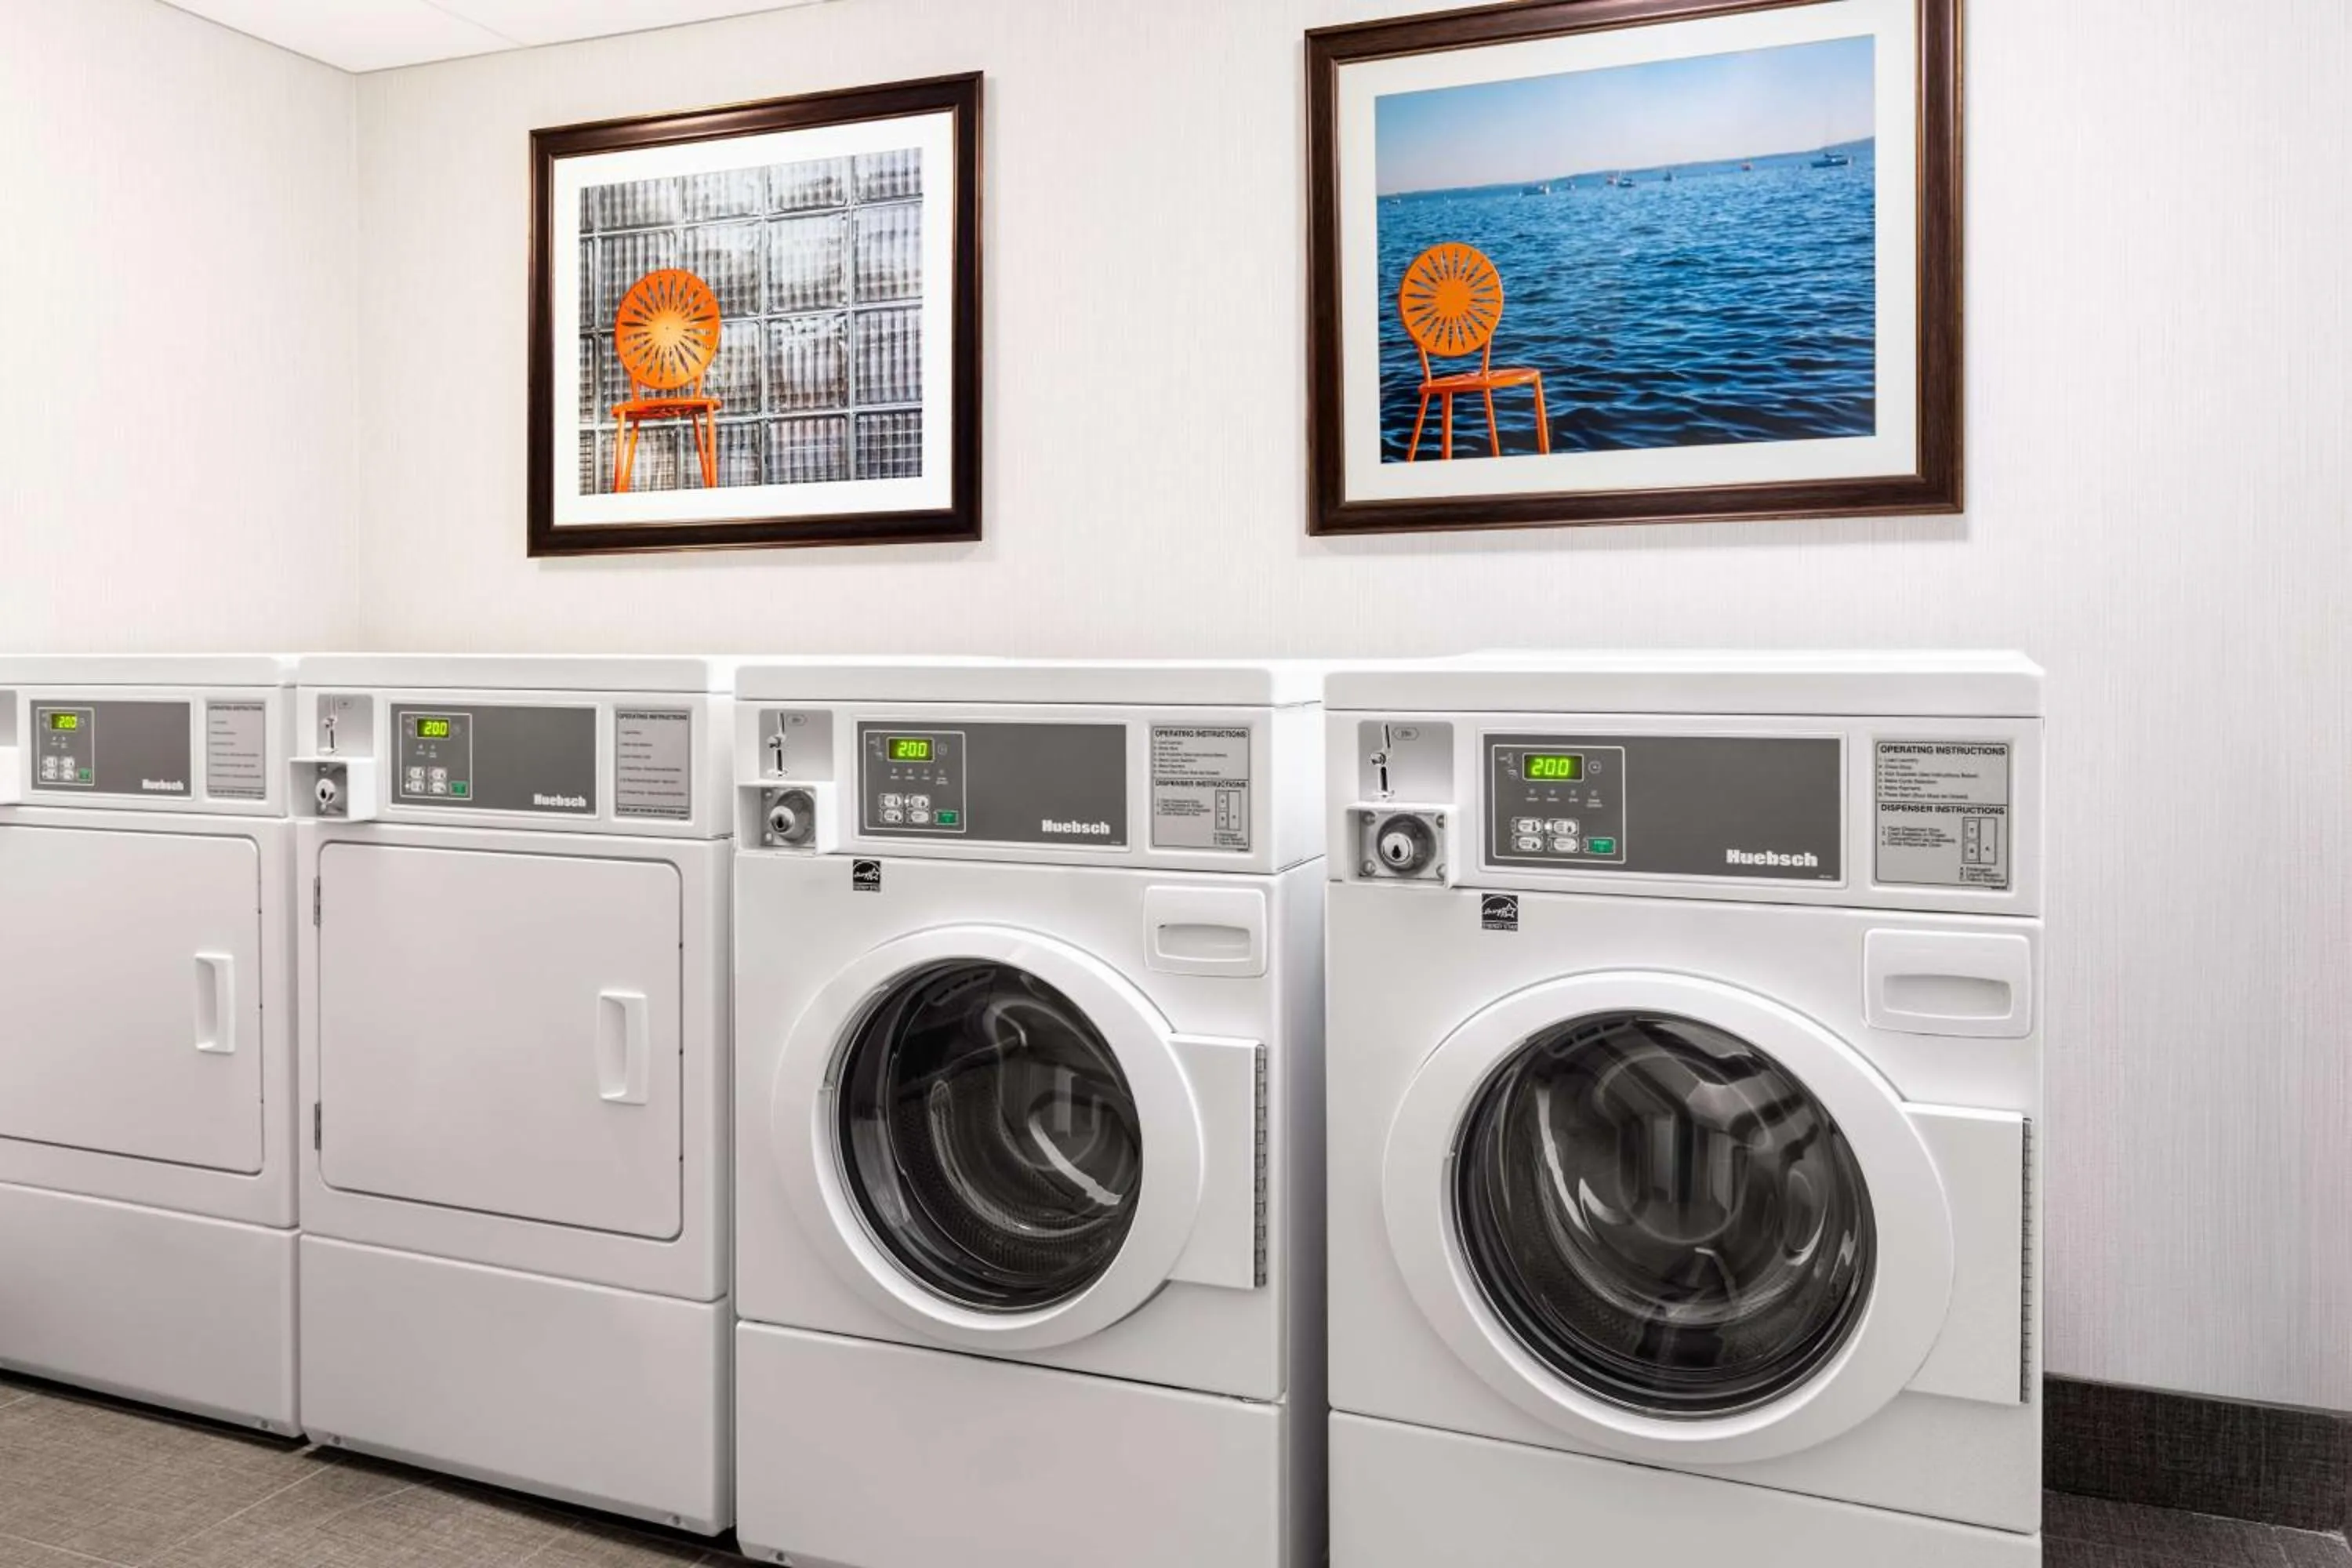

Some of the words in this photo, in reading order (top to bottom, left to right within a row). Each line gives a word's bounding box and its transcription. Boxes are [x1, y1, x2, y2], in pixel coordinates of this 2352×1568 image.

[1880, 745, 1934, 755] OPERATING
[1936, 746, 2006, 756] INSTRUCTIONS
[534, 793, 587, 808] Huebsch
[1881, 804, 1933, 813] DISPENSER
[1935, 805, 2005, 815] INSTRUCTIONS
[1042, 819, 1111, 835] Huebsch
[1726, 848, 1819, 867] Huebsch
